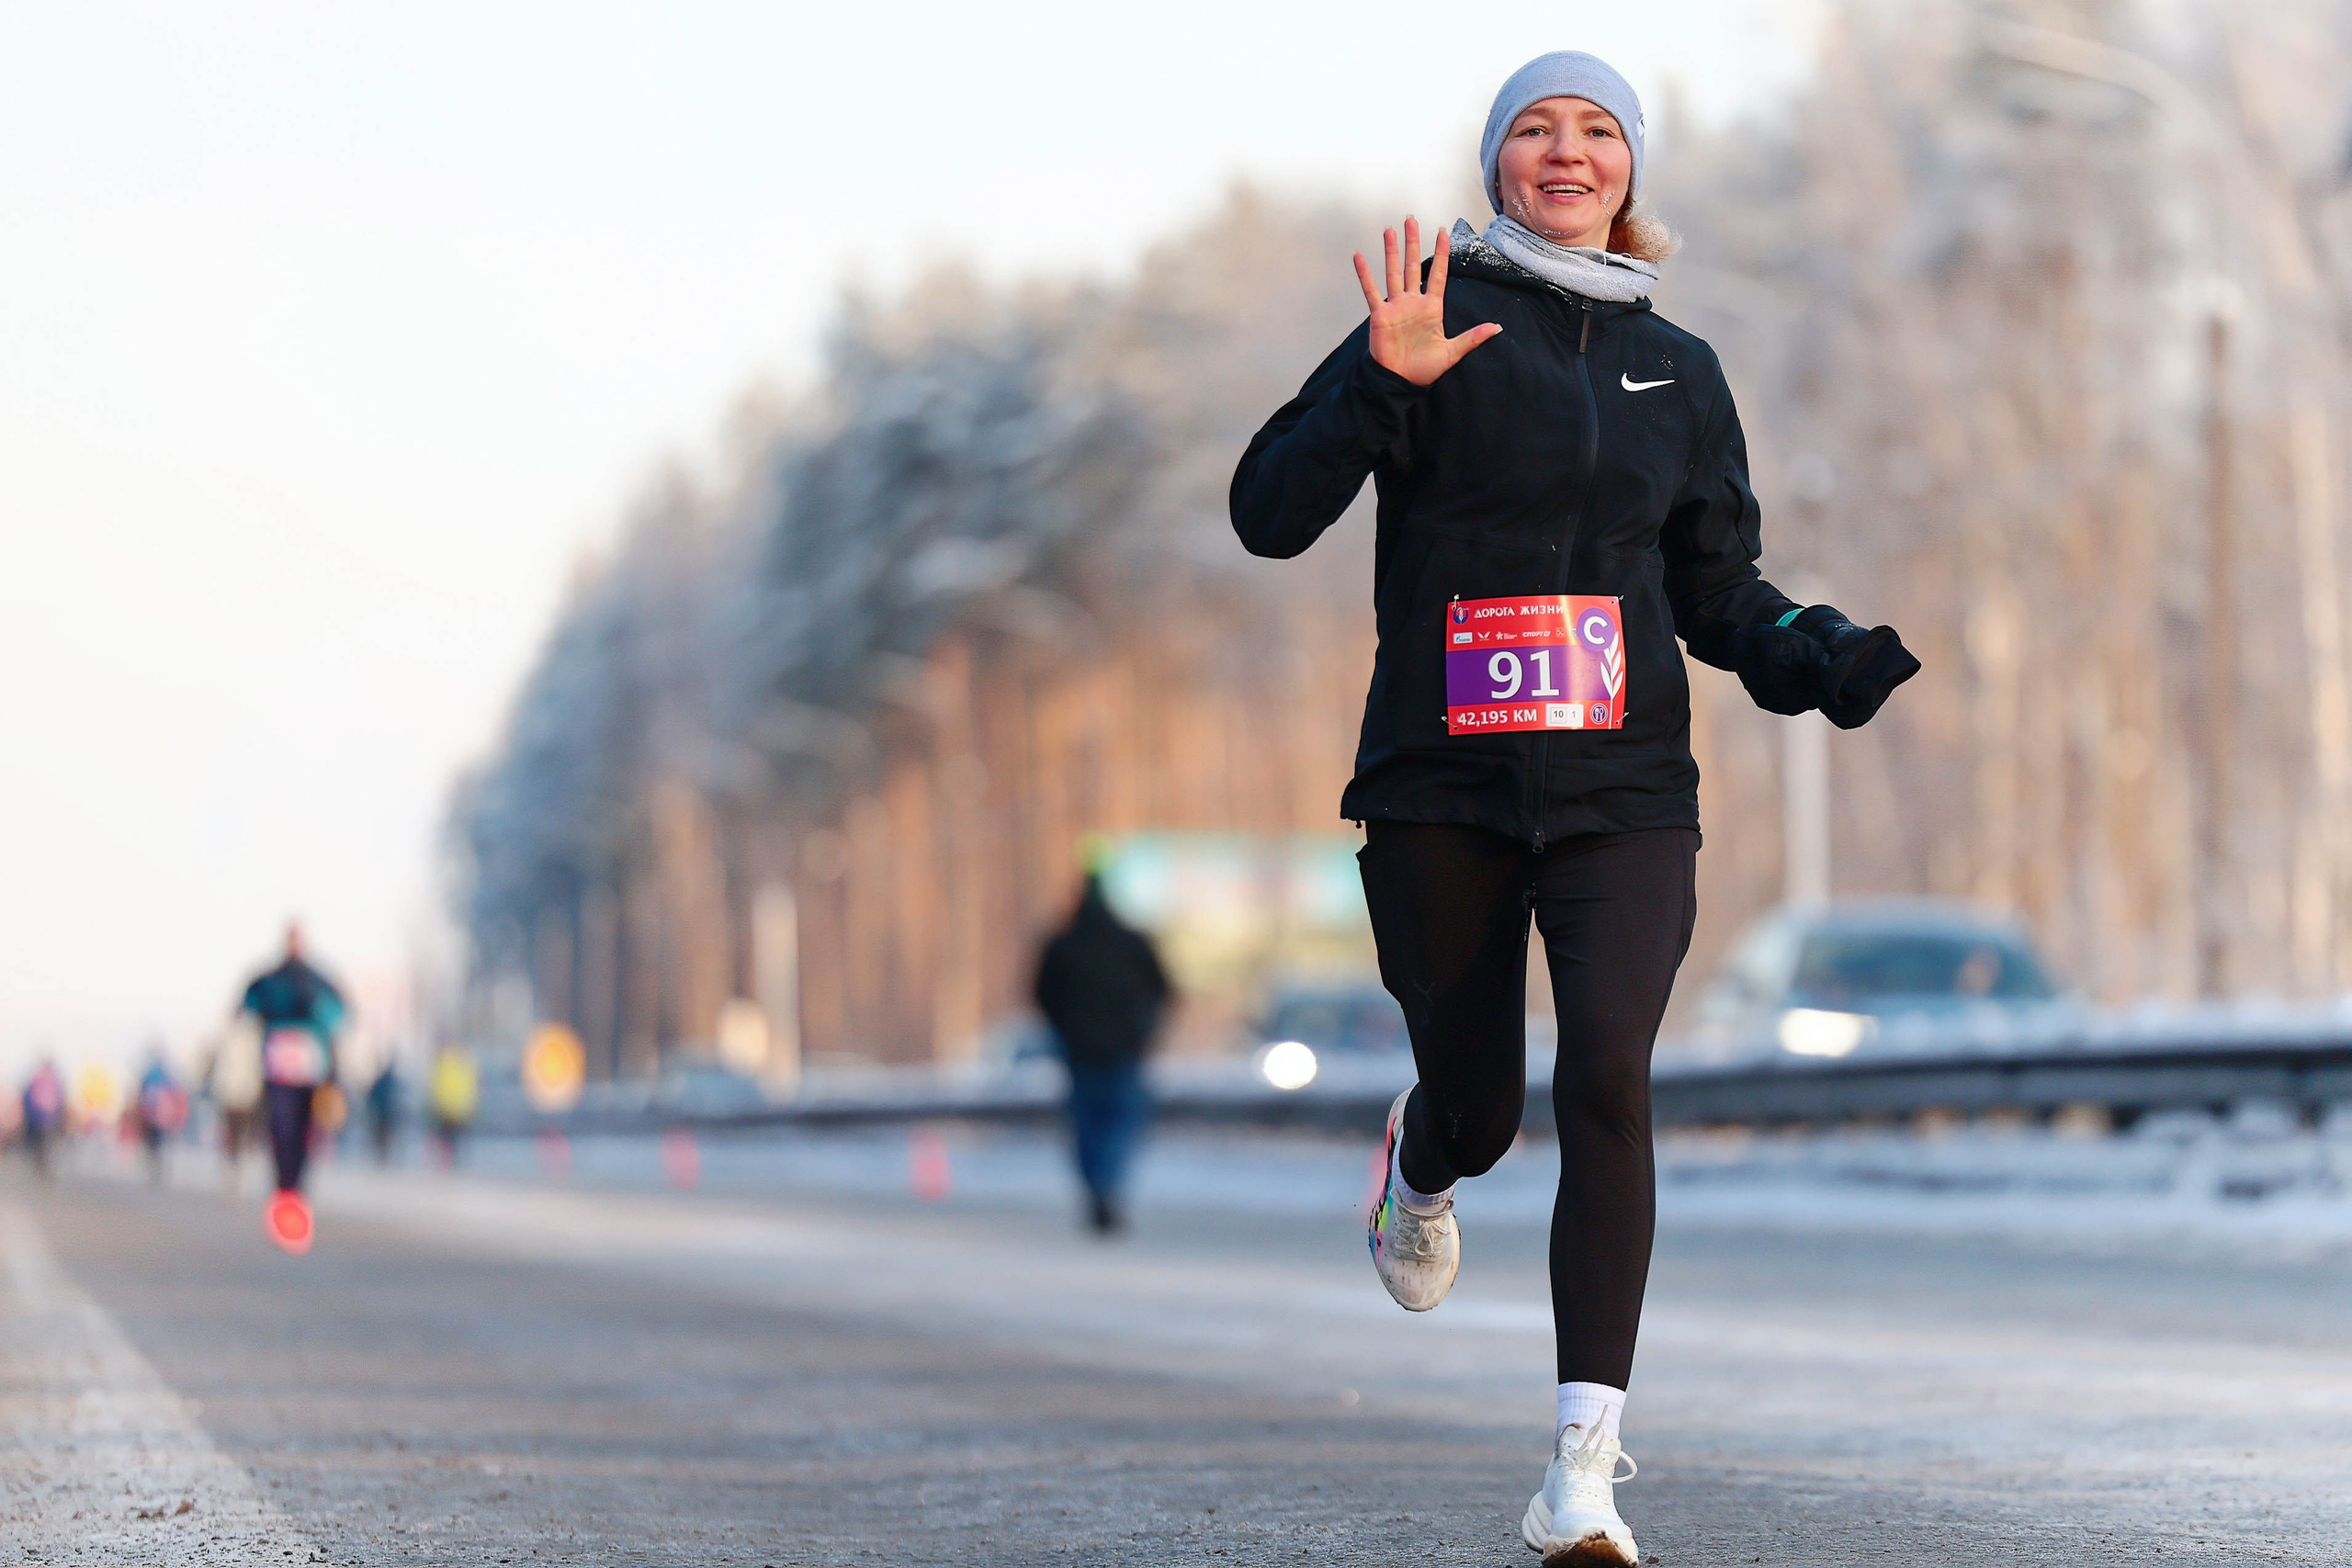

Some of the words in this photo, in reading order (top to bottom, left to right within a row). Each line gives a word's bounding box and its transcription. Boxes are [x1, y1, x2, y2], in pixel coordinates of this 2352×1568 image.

[1474, 606, 1516, 619] ДОРОГА
[1520, 604, 1565, 615] ЖИЗНИ
[1487, 649, 1560, 699] 91
[1457, 710, 1509, 727] 42,195
[1553, 710, 1565, 718] 10
